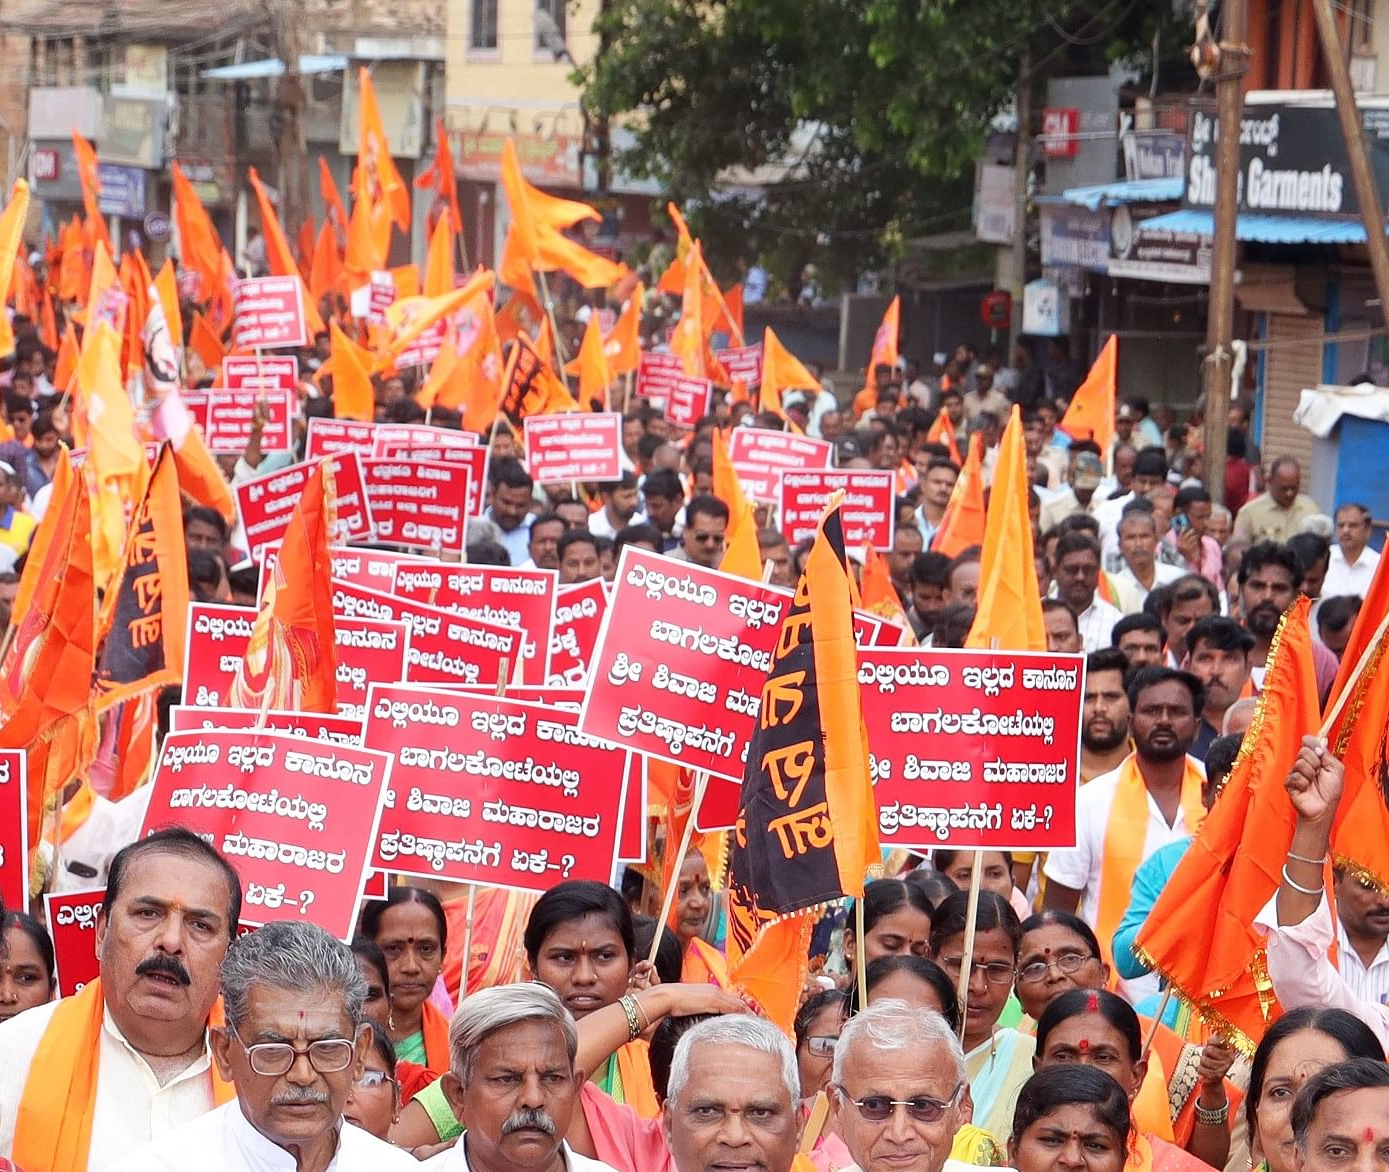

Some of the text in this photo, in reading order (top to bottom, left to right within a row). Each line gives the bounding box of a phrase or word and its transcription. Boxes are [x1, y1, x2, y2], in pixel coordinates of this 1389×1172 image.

[1247, 157, 1343, 212] Garments
[625, 563, 783, 630] ಎಲ್ಲಿಯೂ ಇಲ್ಲದ
[447, 622, 513, 653] ಕಾನೂನ
[608, 651, 717, 705] ಶ್ರೀ ಶಿವಾಜಿ
[858, 660, 1078, 696] ಎಲ್ಲಿಯೂ ಇಲ್ಲದ ಕಾನೂನ
[374, 696, 461, 729] ಎಲ್ಲಿಯೂ
[470, 708, 527, 741] ಇಲ್ಲದ
[618, 703, 735, 757] ಪ್ರತಿಷ್ಠಾಪನೆಗೆ
[890, 708, 1055, 745] ಬಾಗಲಕೋಟೆಯಲ್ಲಿ
[163, 740, 376, 786] ಎಲ್ಲಿಯೂ ಇಲ್ಲದ ಕಾನೂನ
[399, 746, 581, 798] ಬಾಗಲಕೋಟೆಯಲ್ಲಿ
[903, 752, 972, 783] ಶಿವಾಜಿ
[983, 757, 1068, 784] ಮಹಾರಾಜರ
[169, 784, 328, 832] ಬಾಗಲಕೋಟೆಯಲ್ಲಿ
[406, 786, 601, 838] ಶಿವಾಜಿ ಮಹಾರಾಜರ
[878, 802, 1004, 840] ಪ್ರತಿಷ್ಠಾಪನೆಗೆ
[222, 829, 347, 875] ಮಹಾರಾಜರ
[379, 830, 501, 871] ಪ್ರತಿಷ್ಠಾಪನೆಗೆ
